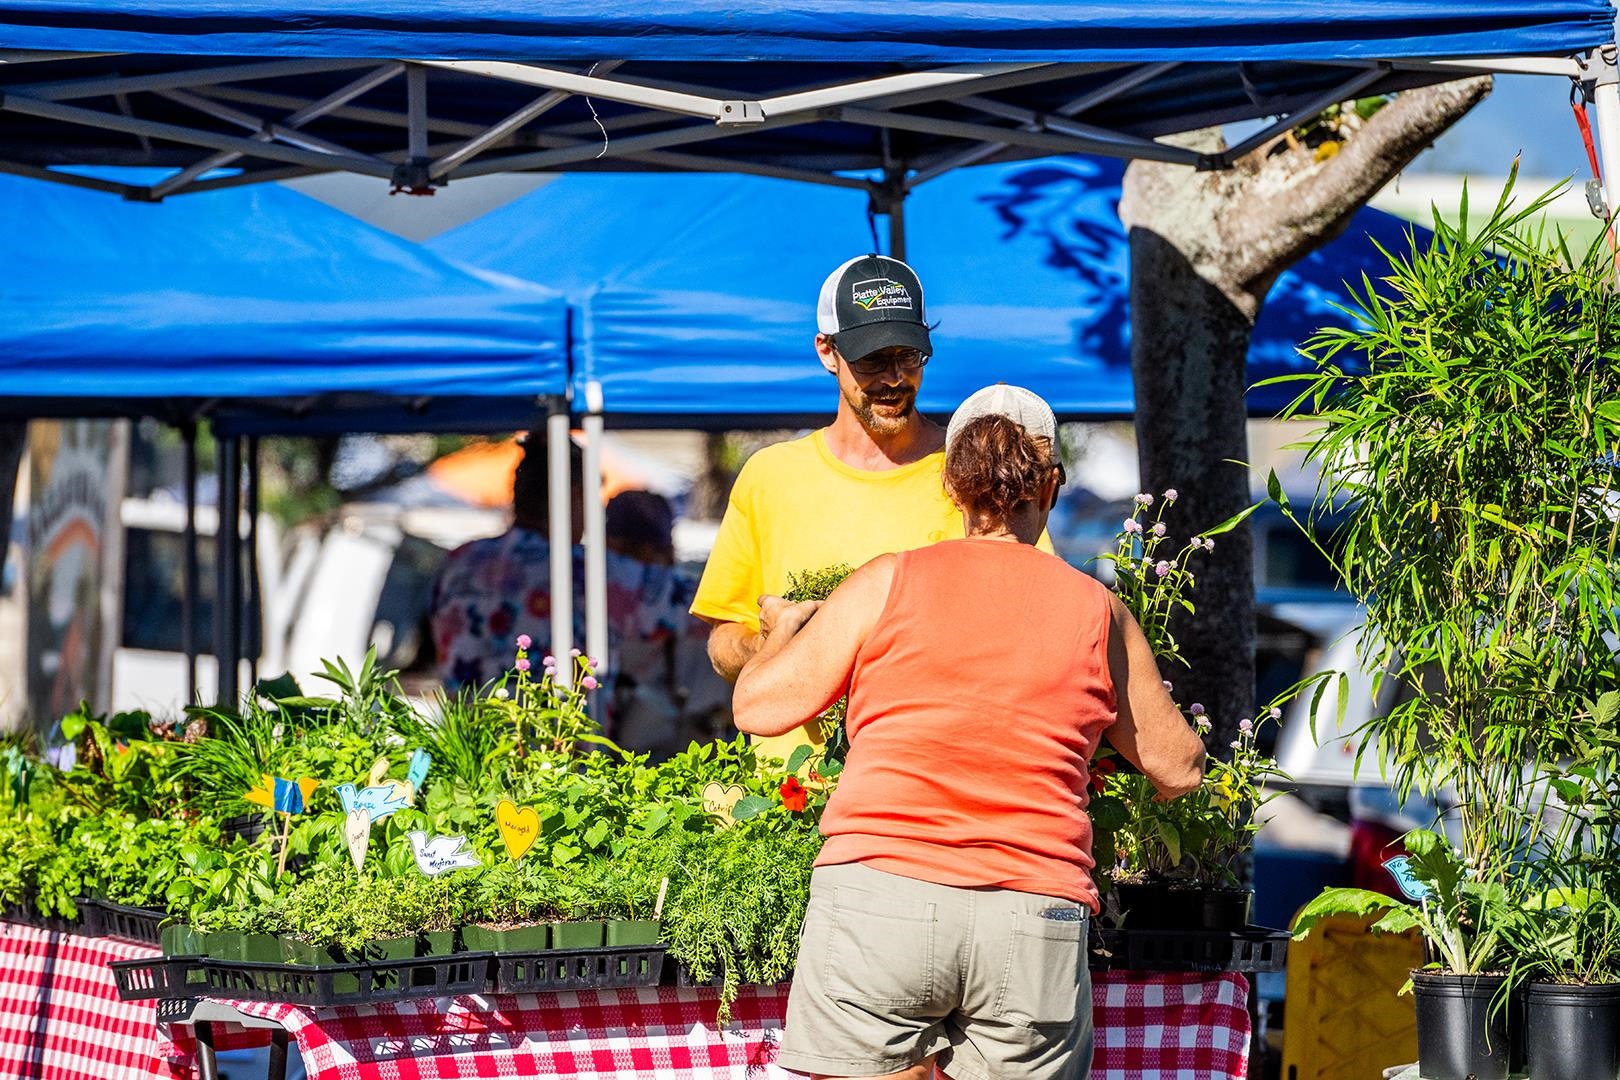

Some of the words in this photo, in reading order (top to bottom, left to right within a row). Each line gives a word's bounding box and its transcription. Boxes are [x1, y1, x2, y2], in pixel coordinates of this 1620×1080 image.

[853, 288, 878, 301] Platte
[879, 284, 905, 296] Valley
[876, 296, 912, 306] Equipment
